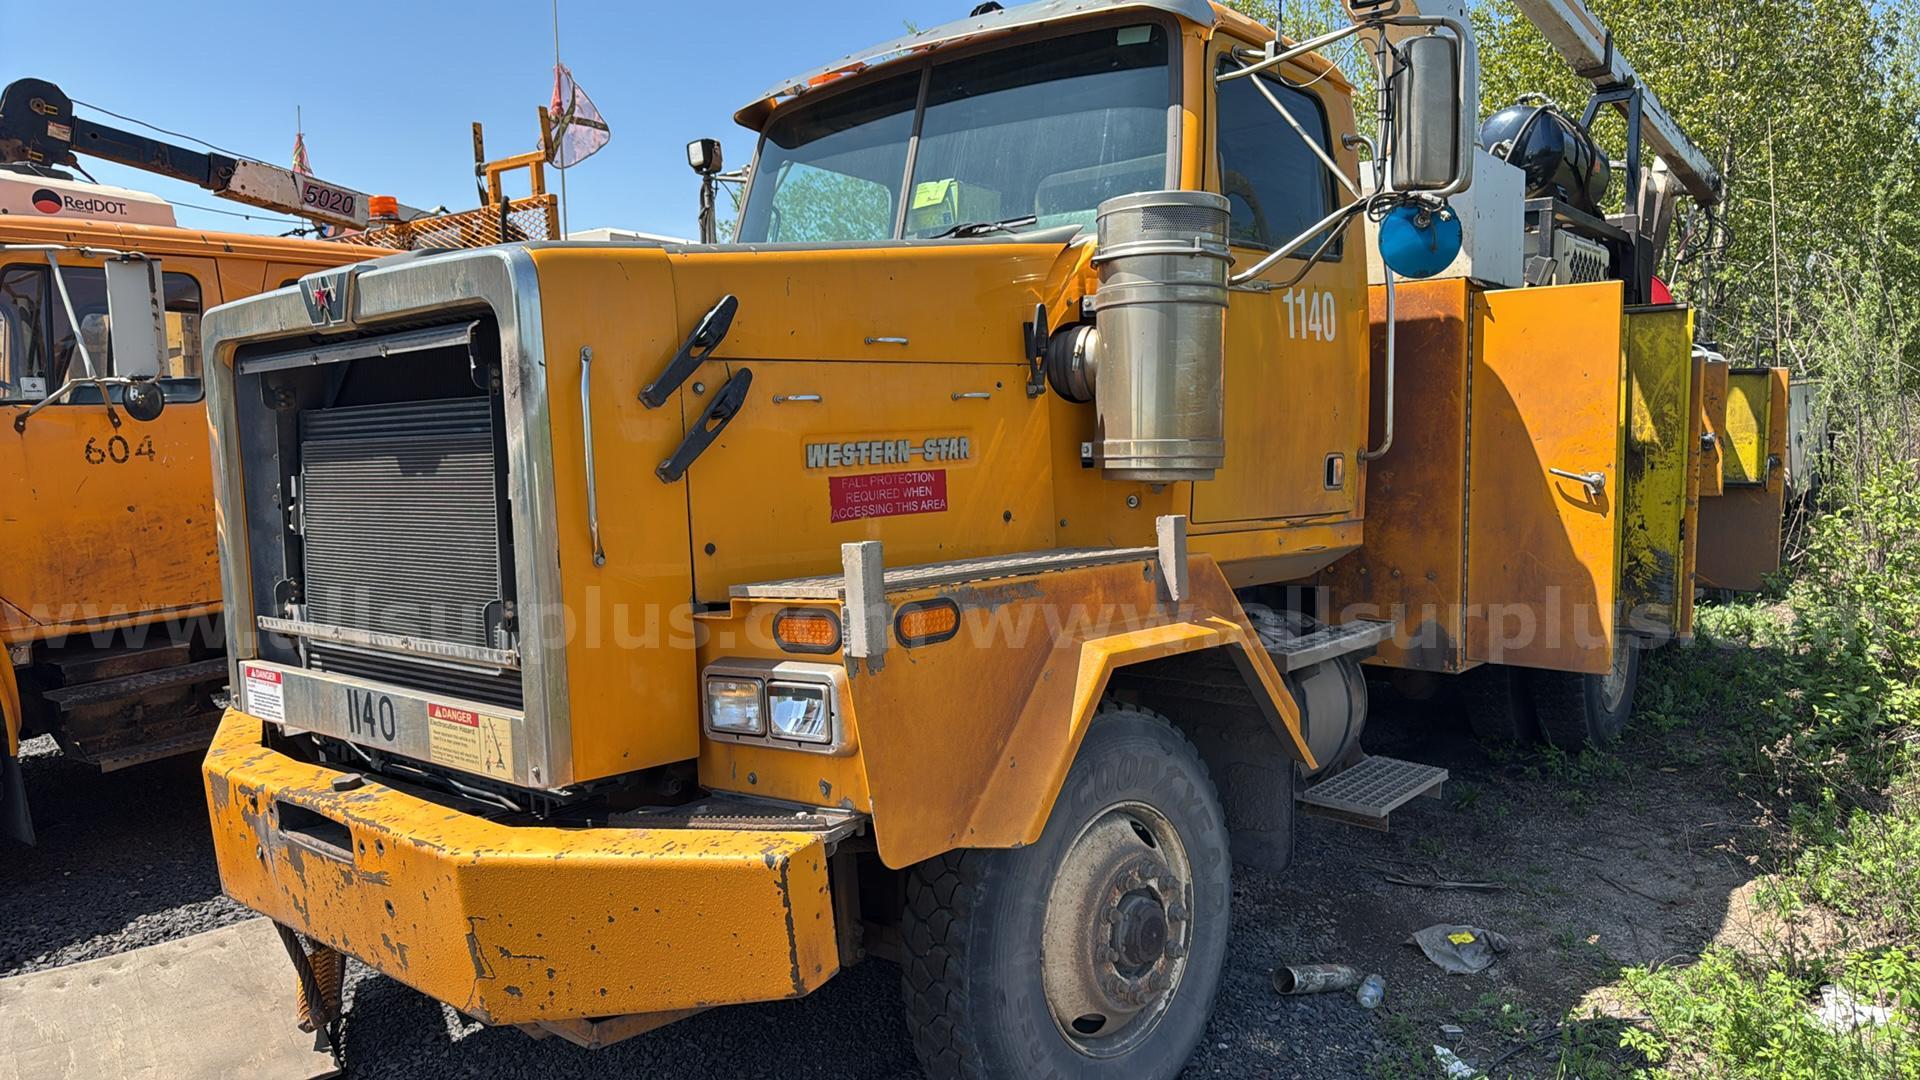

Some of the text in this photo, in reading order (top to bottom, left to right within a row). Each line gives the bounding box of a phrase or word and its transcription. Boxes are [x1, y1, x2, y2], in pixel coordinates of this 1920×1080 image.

[304, 185, 354, 213] 5020
[1282, 287, 1336, 342] 1140
[85, 435, 156, 465] 604
[841, 472, 935, 489] FALL PROTECTION
[846, 485, 933, 504] REQUIRED WHEN
[832, 497, 947, 521] ACCESSING THIS AREA
[256, 669, 276, 682] DANGER
[346, 688, 396, 742] 1140
[441, 707, 473, 725] DANGER
